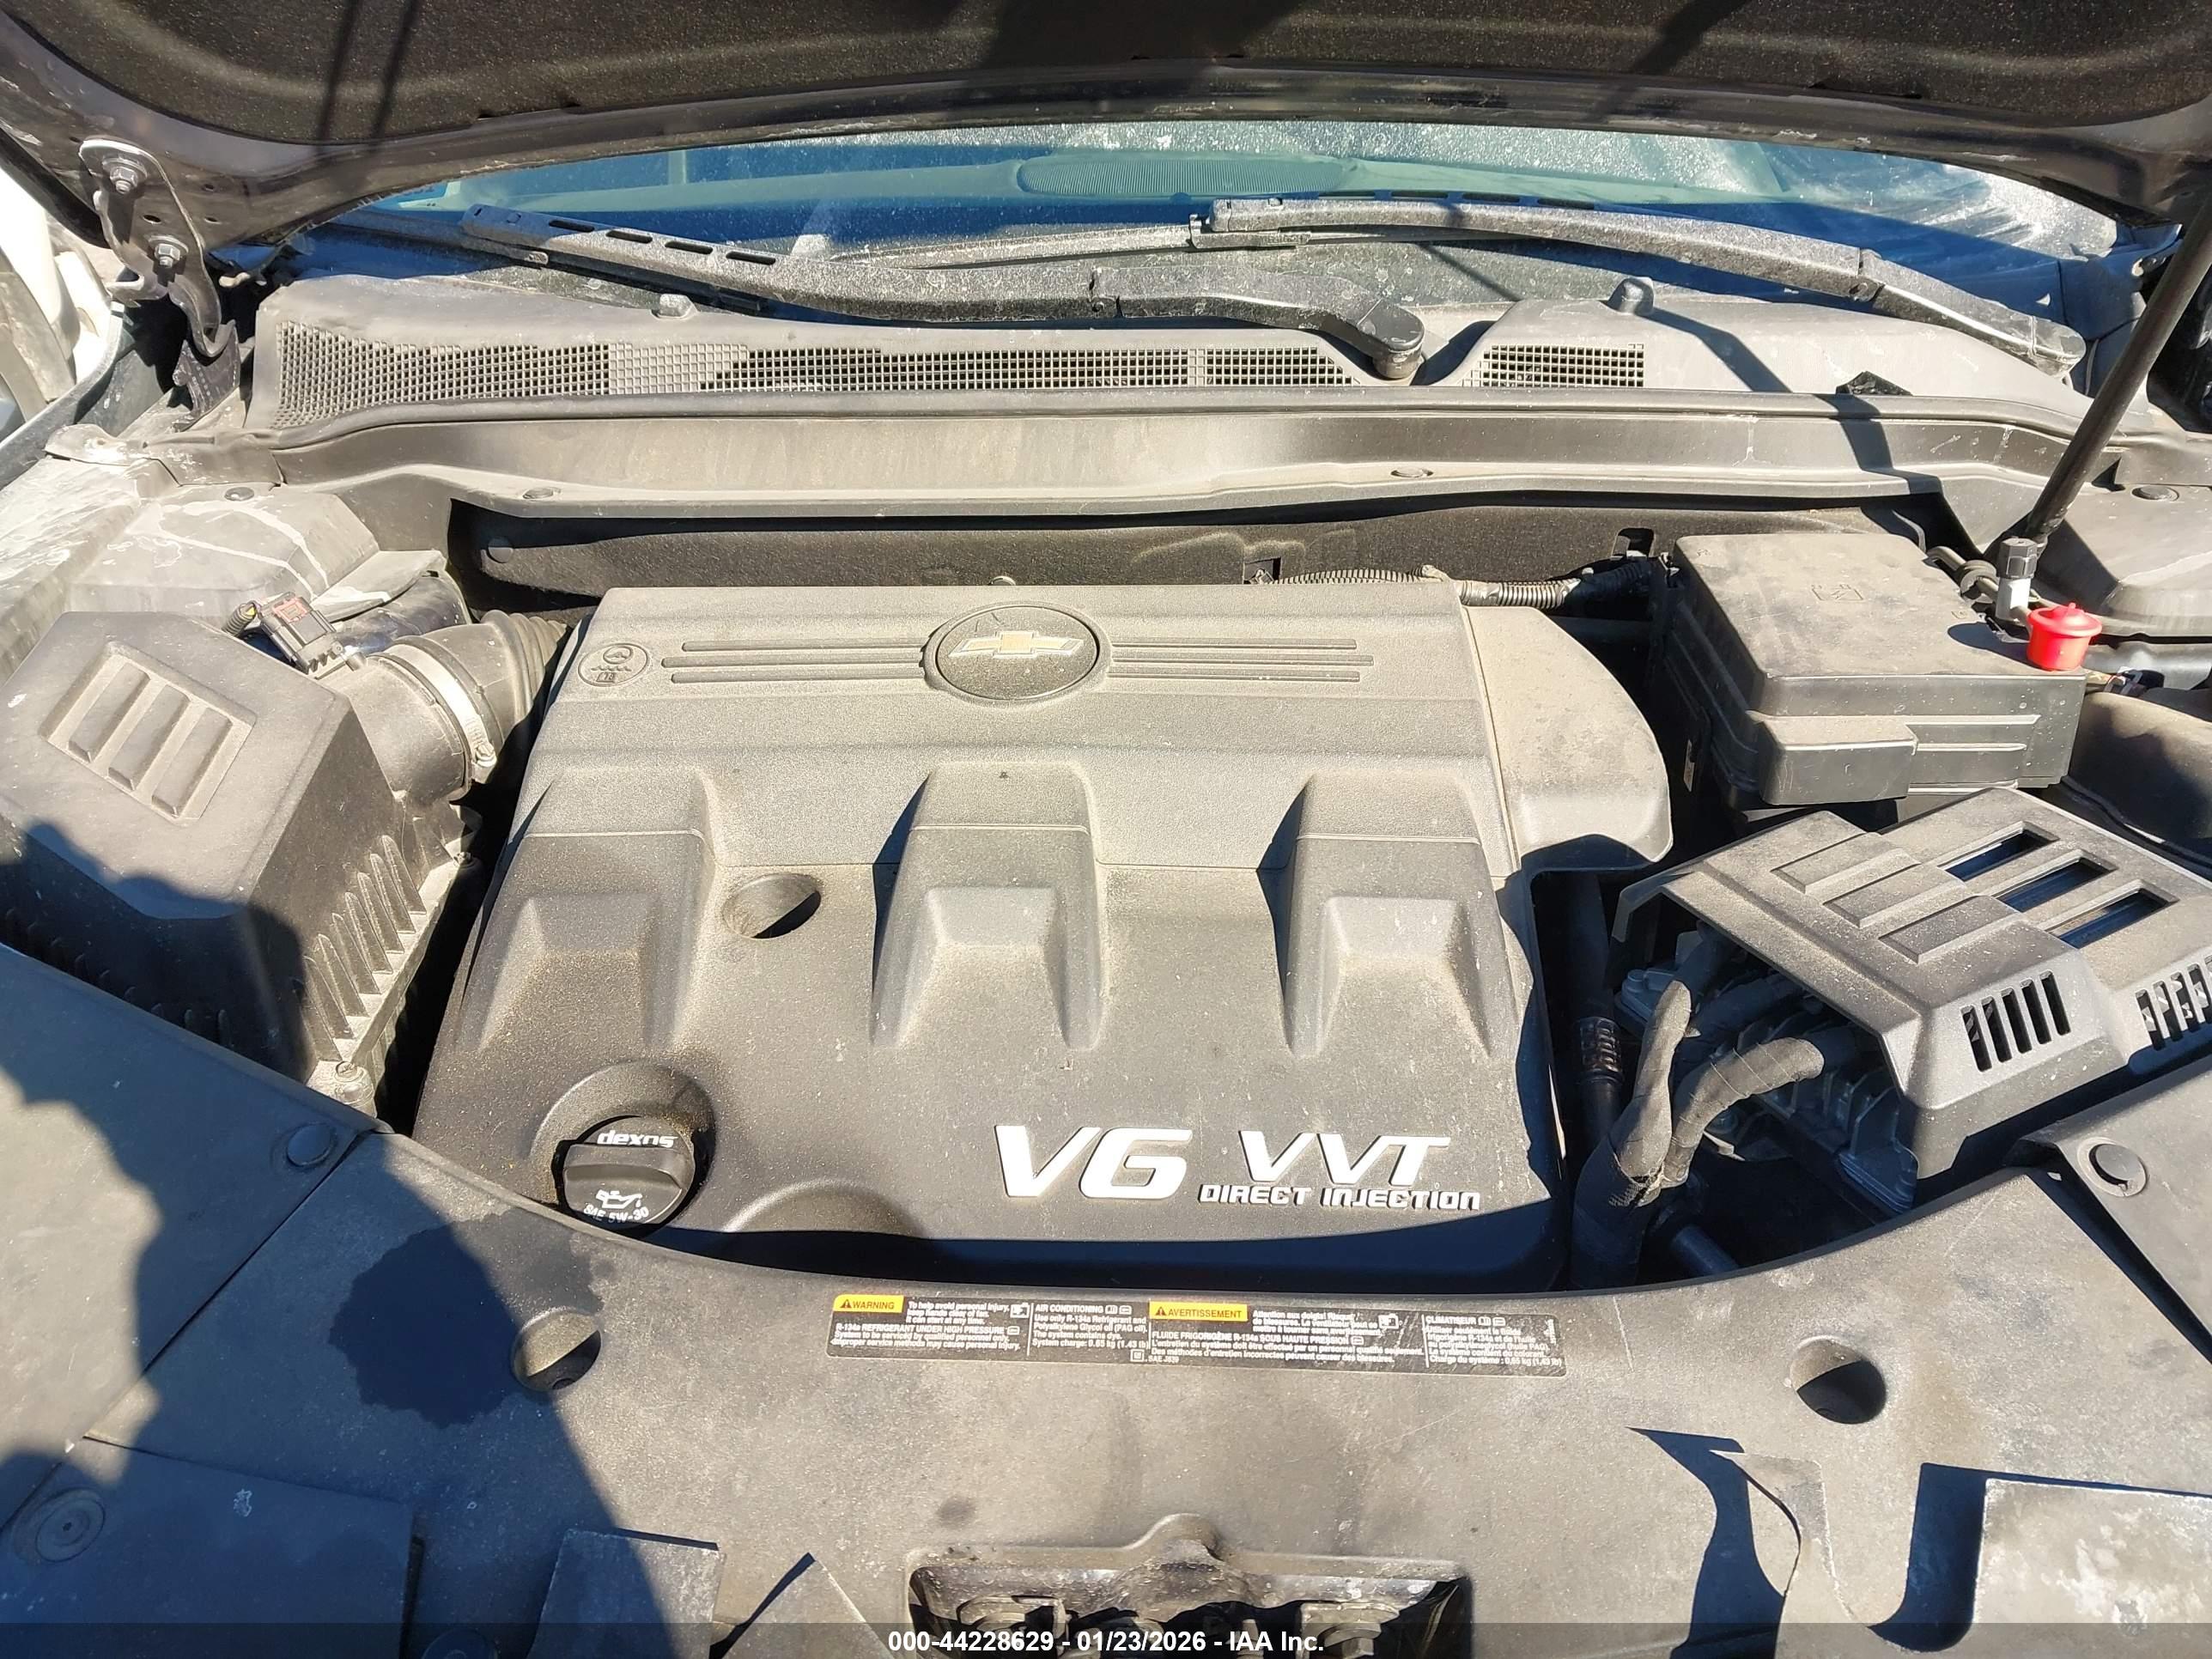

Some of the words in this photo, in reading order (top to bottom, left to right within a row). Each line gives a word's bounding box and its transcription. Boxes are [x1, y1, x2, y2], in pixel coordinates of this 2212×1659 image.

[994, 1125, 1193, 1200] V6
[1238, 1130, 1451, 1186] VVT
[1198, 1184, 1311, 1206] DIRECT
[1320, 1187, 1480, 1211] INJECTION
[584, 1205, 605, 1223] SAE
[608, 1206, 649, 1223] 5W-30
[853, 1301, 894, 1310] WARNING
[1168, 1309, 1242, 1318] AVERTISSEMENT
[1152, 1331, 1179, 1340] FLUIDE
